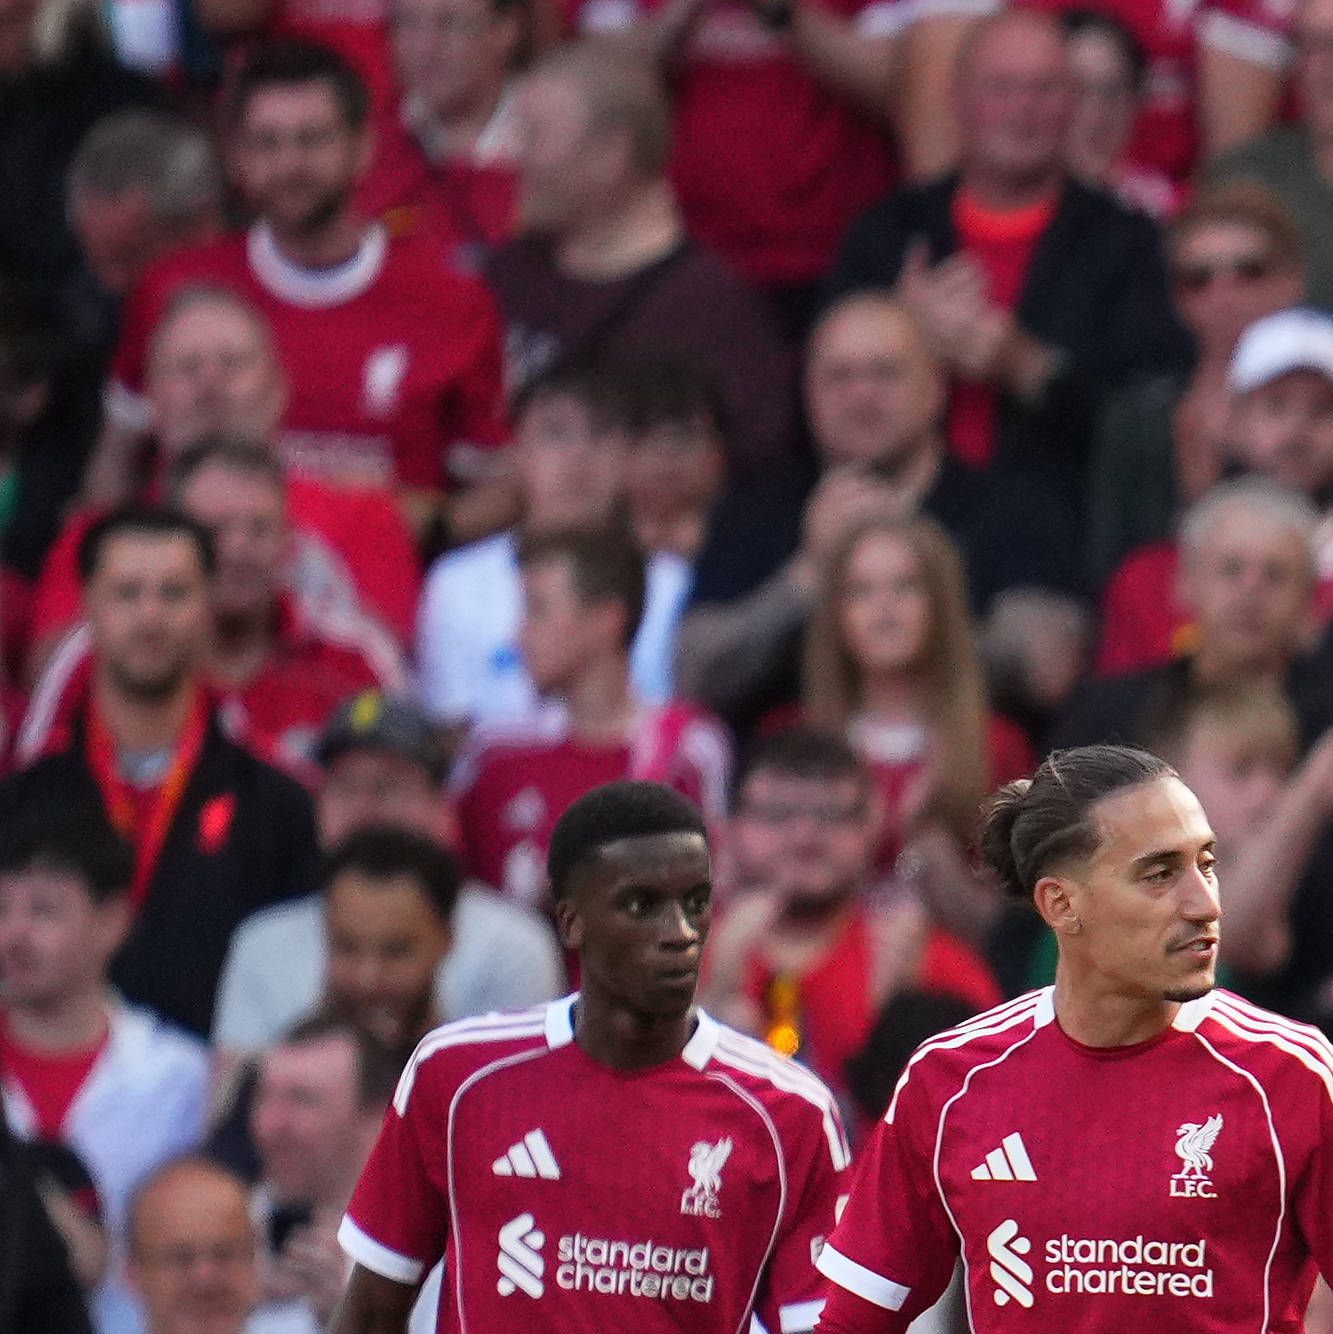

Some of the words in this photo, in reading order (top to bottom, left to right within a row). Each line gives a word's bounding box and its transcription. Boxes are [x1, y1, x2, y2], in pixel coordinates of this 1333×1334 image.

[557, 1232, 710, 1275] standard
[1045, 1234, 1206, 1267] standard
[556, 1262, 714, 1303] chartered
[1045, 1264, 1214, 1298] chartered
